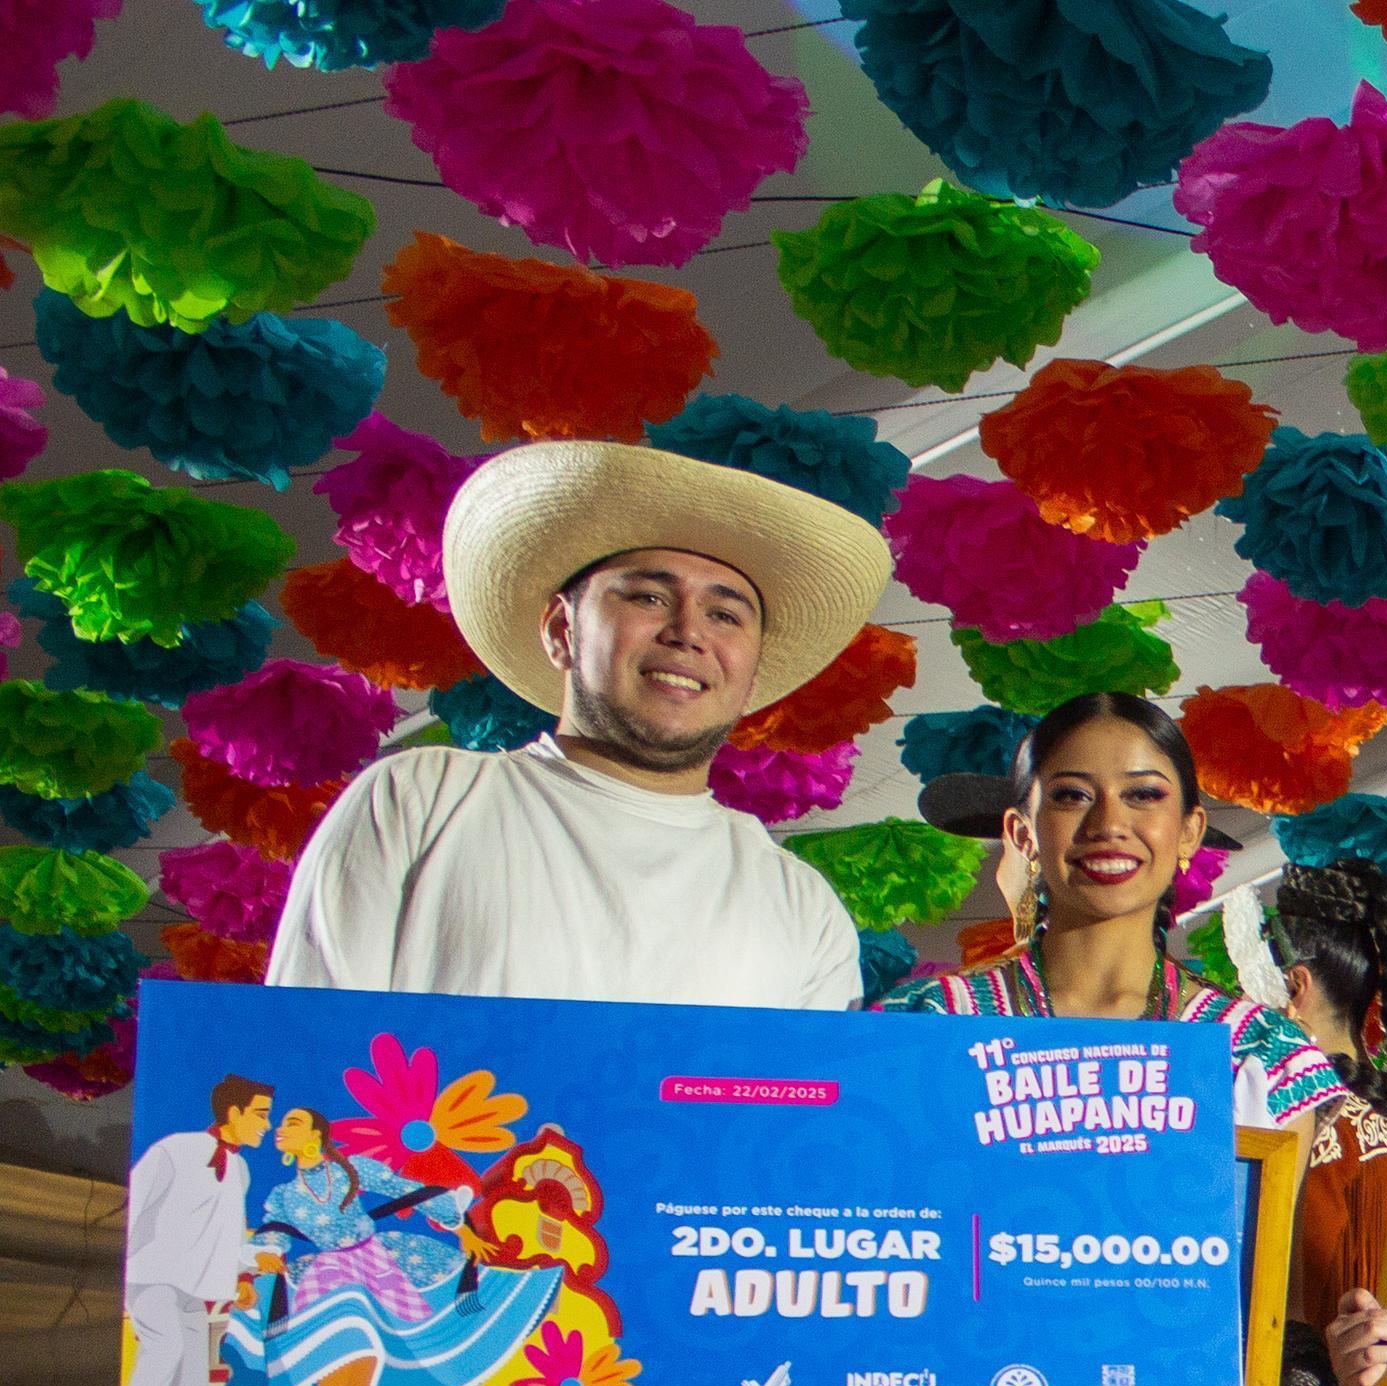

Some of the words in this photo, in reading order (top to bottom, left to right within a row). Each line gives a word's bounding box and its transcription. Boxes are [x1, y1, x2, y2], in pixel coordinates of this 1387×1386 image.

[1011, 1048, 1080, 1065] CONCURSO
[1083, 1044, 1148, 1059] NACIONAL
[1151, 1045, 1169, 1057] DE
[675, 1084, 725, 1096] Fecha:
[732, 1085, 826, 1099] 22/02/2025
[986, 1061, 1101, 1106] BAILE
[1119, 1060, 1169, 1093] DE
[975, 1096, 1196, 1145] HUAPANGO
[1020, 1142, 1034, 1153] EL
[1096, 1134, 1149, 1153] 2025
[656, 1202, 717, 1216] Páguese
[722, 1205, 747, 1216] por
[751, 1205, 782, 1216] este
[787, 1205, 839, 1218] cheque
[843, 1209, 852, 1217] a
[856, 1206, 869, 1218] la
[873, 1207, 915, 1218] orden
[920, 1208, 942, 1219] de:
[672, 1227, 777, 1257] 2DO.
[789, 1229, 941, 1259] LUGAR
[989, 1232, 1229, 1269] $15,000.00
[690, 1269, 928, 1317] ADULTO
[1024, 1277, 1066, 1287] Quince
[1071, 1277, 1090, 1286] mil
[1094, 1279, 1129, 1289] pesos
